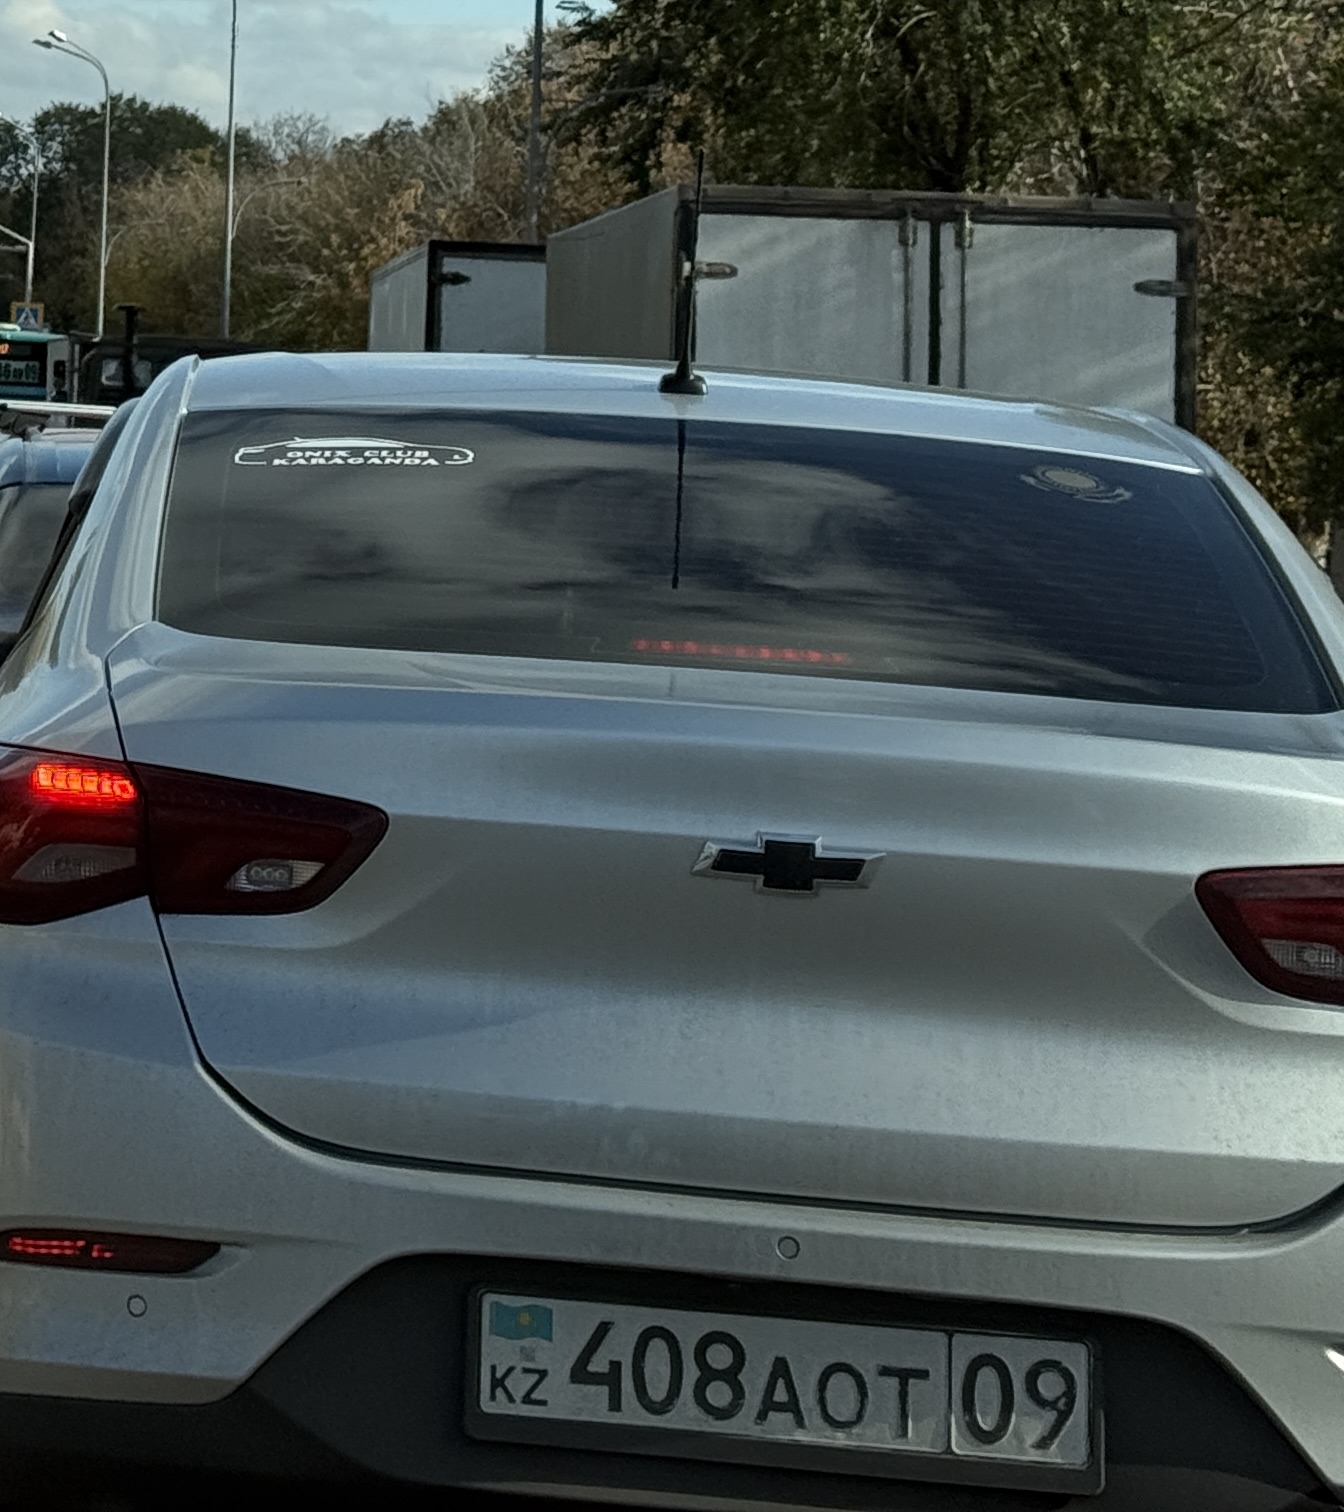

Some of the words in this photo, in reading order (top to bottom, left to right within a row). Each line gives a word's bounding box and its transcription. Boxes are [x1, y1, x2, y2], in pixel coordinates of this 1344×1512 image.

[286, 450, 352, 458] ONIX
[363, 450, 429, 458] CLUB
[271, 457, 440, 467] KARAGANDA
[488, 1364, 549, 1407] KZ
[961, 1351, 1078, 1452] 09
